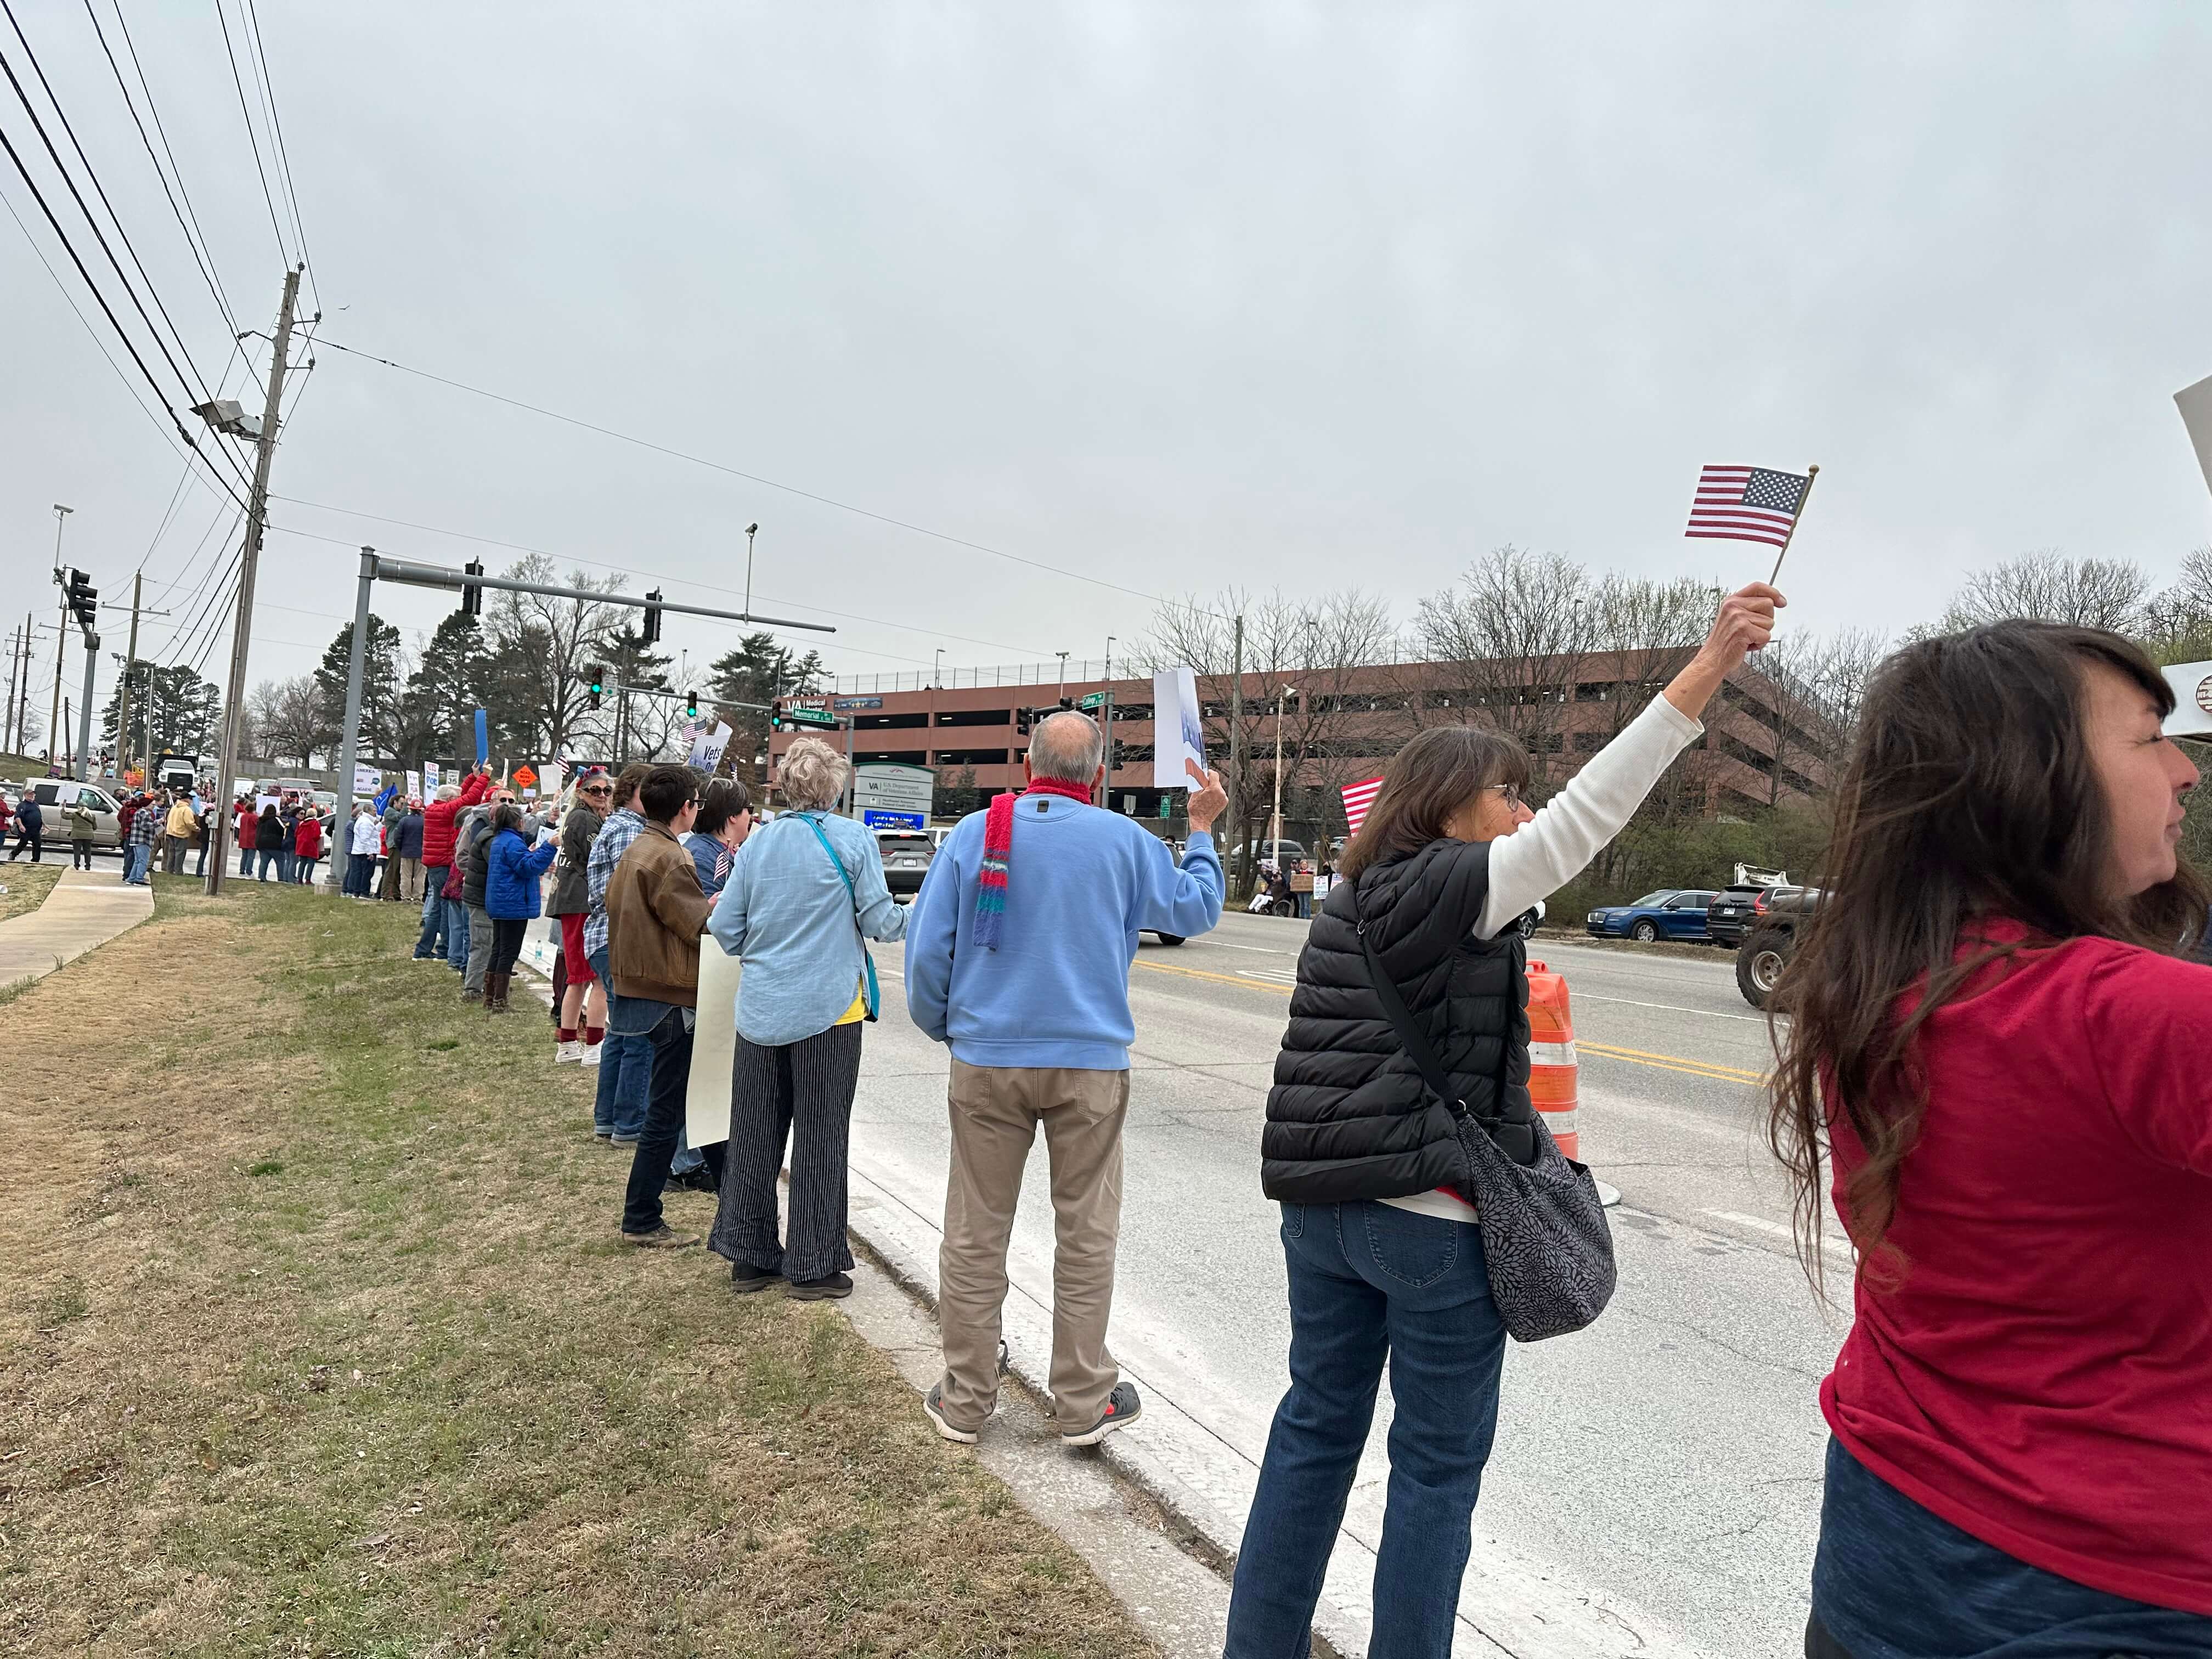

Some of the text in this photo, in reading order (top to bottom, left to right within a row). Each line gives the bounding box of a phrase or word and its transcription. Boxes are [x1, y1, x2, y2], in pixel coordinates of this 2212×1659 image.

[787, 700, 802, 711] VA
[795, 710, 819, 720] Memorial
[703, 746, 721, 760] Vets
